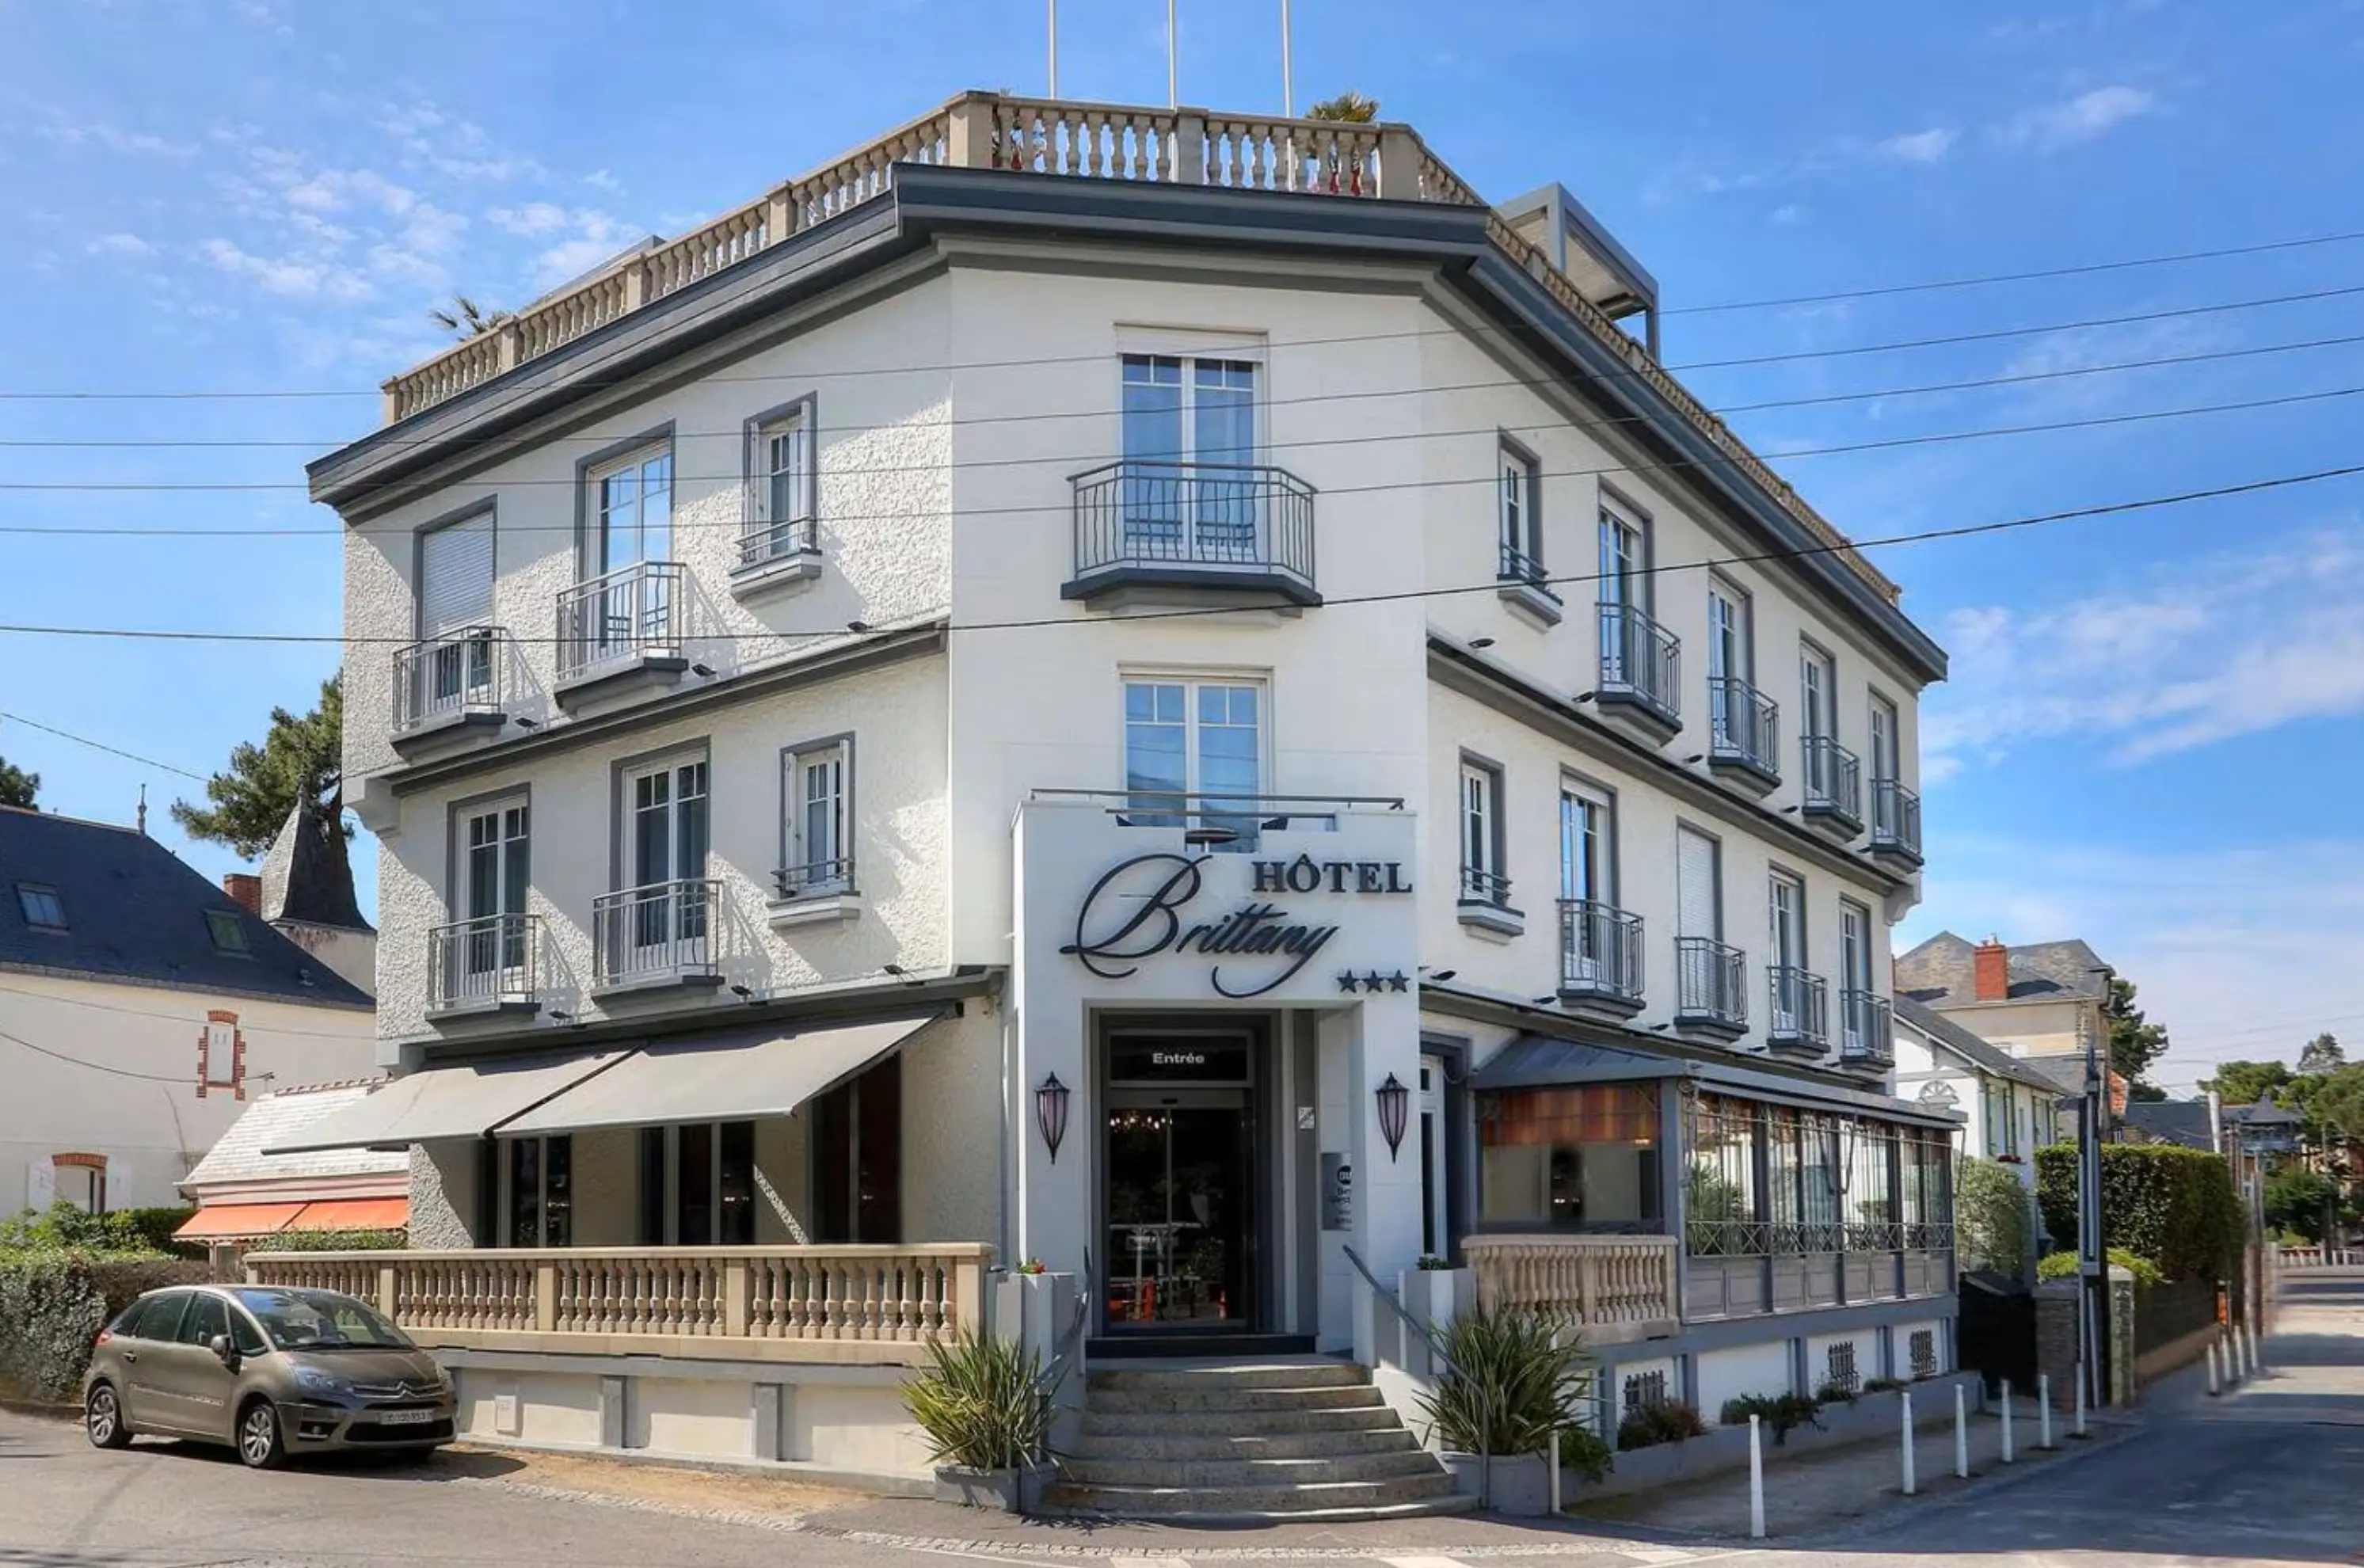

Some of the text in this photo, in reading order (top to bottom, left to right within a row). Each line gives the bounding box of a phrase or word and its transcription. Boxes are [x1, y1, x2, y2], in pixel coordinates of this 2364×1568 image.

[1252, 854, 1413, 892] HÔTEL
[1059, 853, 1339, 998] Brittany
[1152, 1052, 1205, 1064] Entrée
